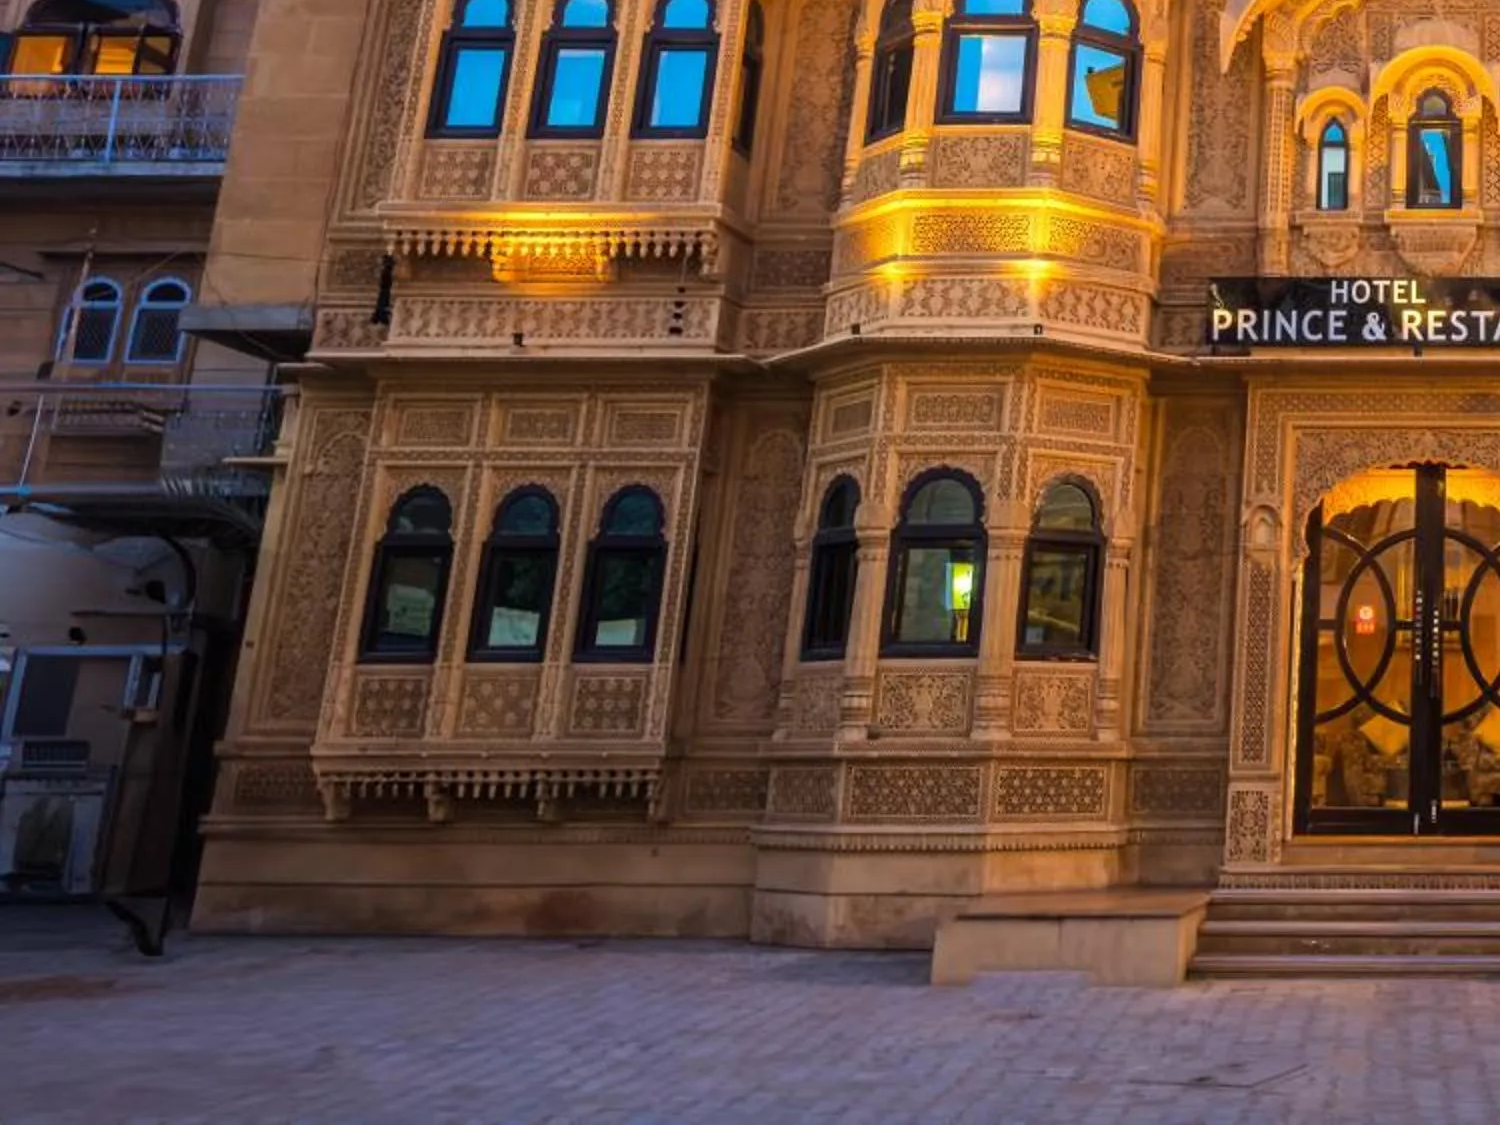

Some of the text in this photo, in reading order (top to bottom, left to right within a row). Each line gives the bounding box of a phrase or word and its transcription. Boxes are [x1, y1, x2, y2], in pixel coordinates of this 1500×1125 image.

[1331, 280, 1426, 305] HOTEL
[1212, 309, 1348, 341] PRINCE
[1361, 312, 1388, 341] &
